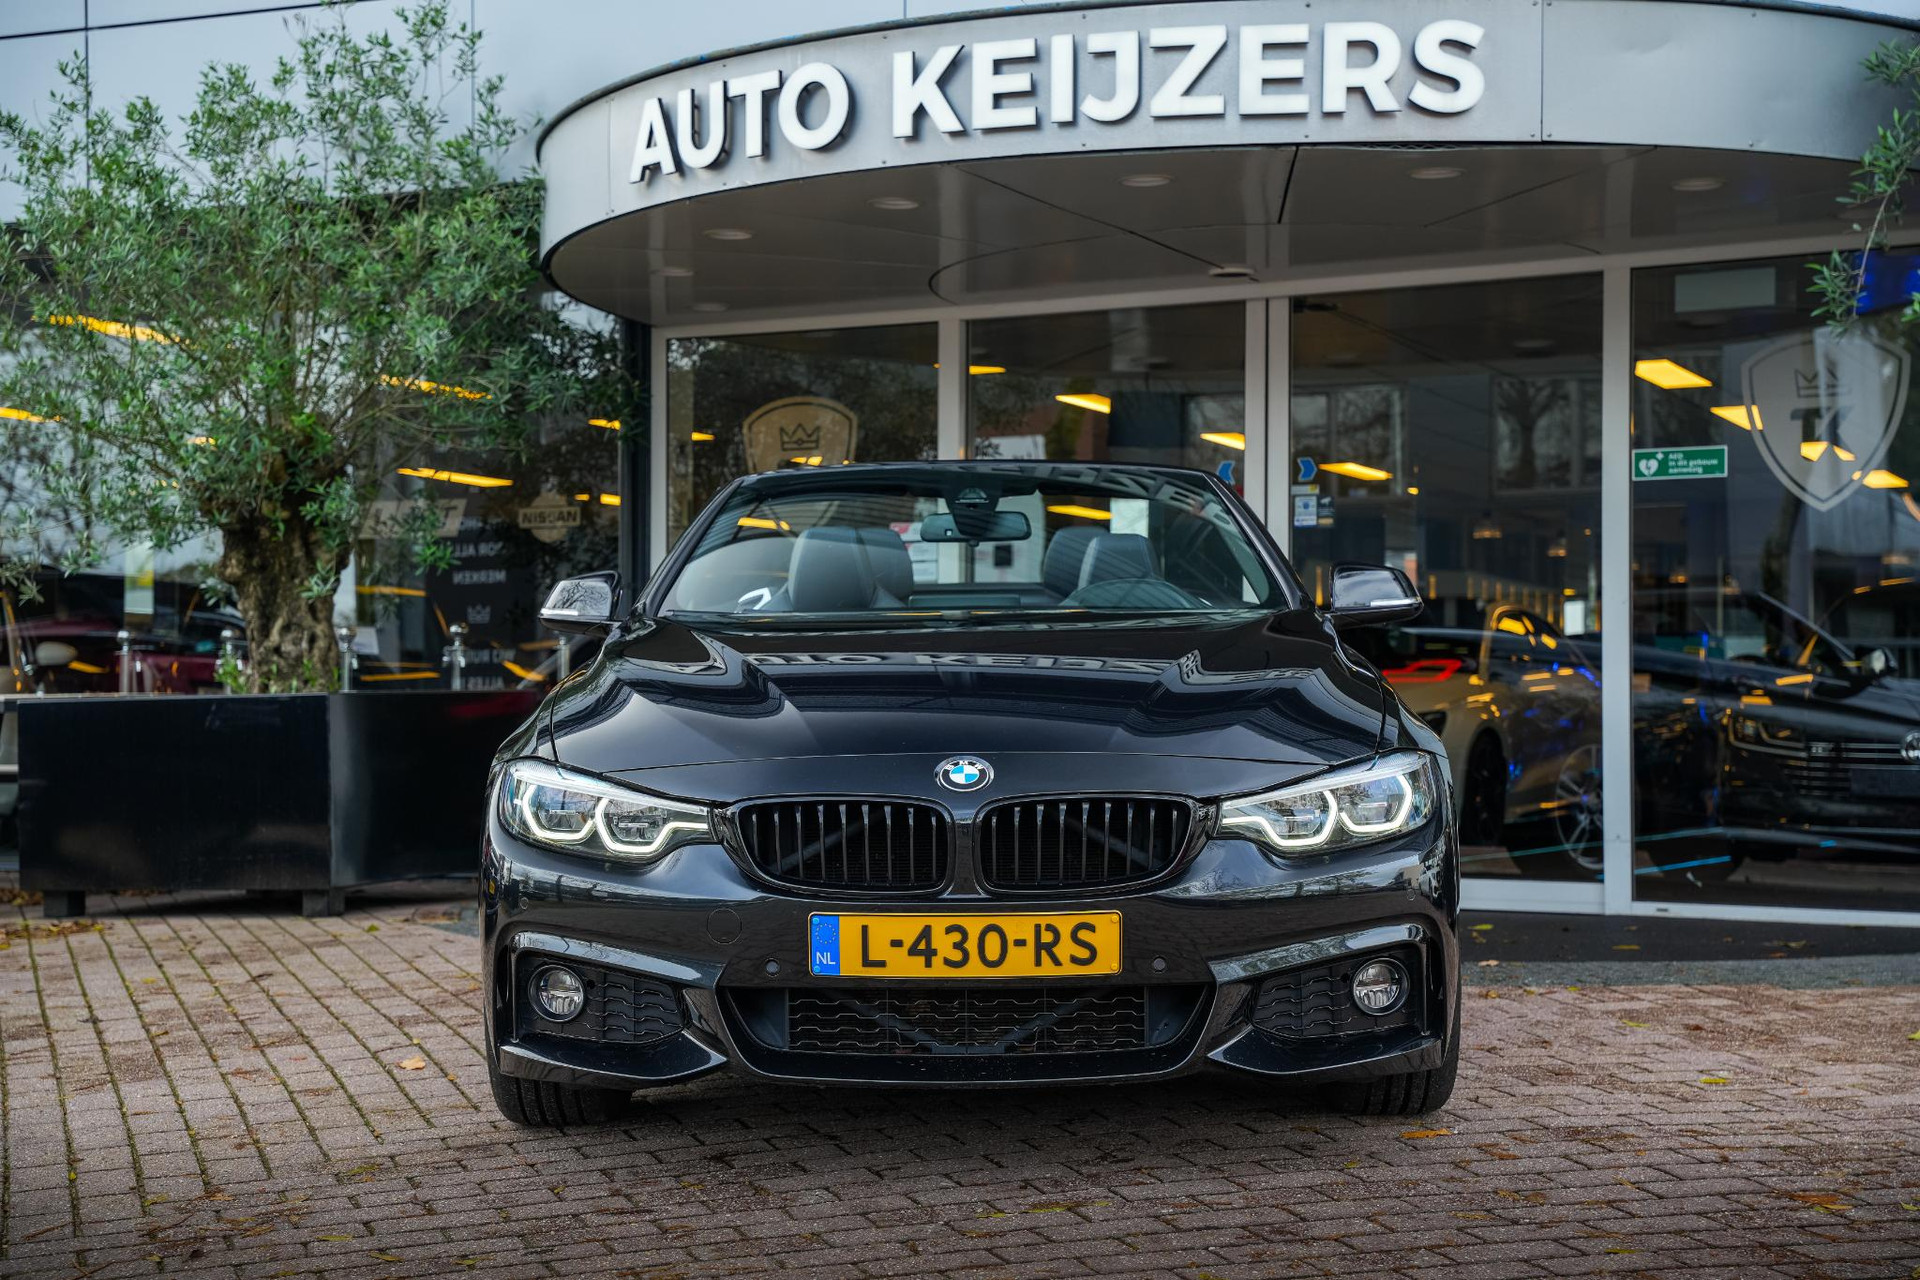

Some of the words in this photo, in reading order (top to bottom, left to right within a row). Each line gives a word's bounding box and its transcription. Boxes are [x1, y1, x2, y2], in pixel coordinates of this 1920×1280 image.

[628, 61, 852, 184] AUTO
[892, 18, 1487, 140] KEIJZERS
[816, 951, 836, 965] NL
[861, 922, 1098, 969] L-430-RS
